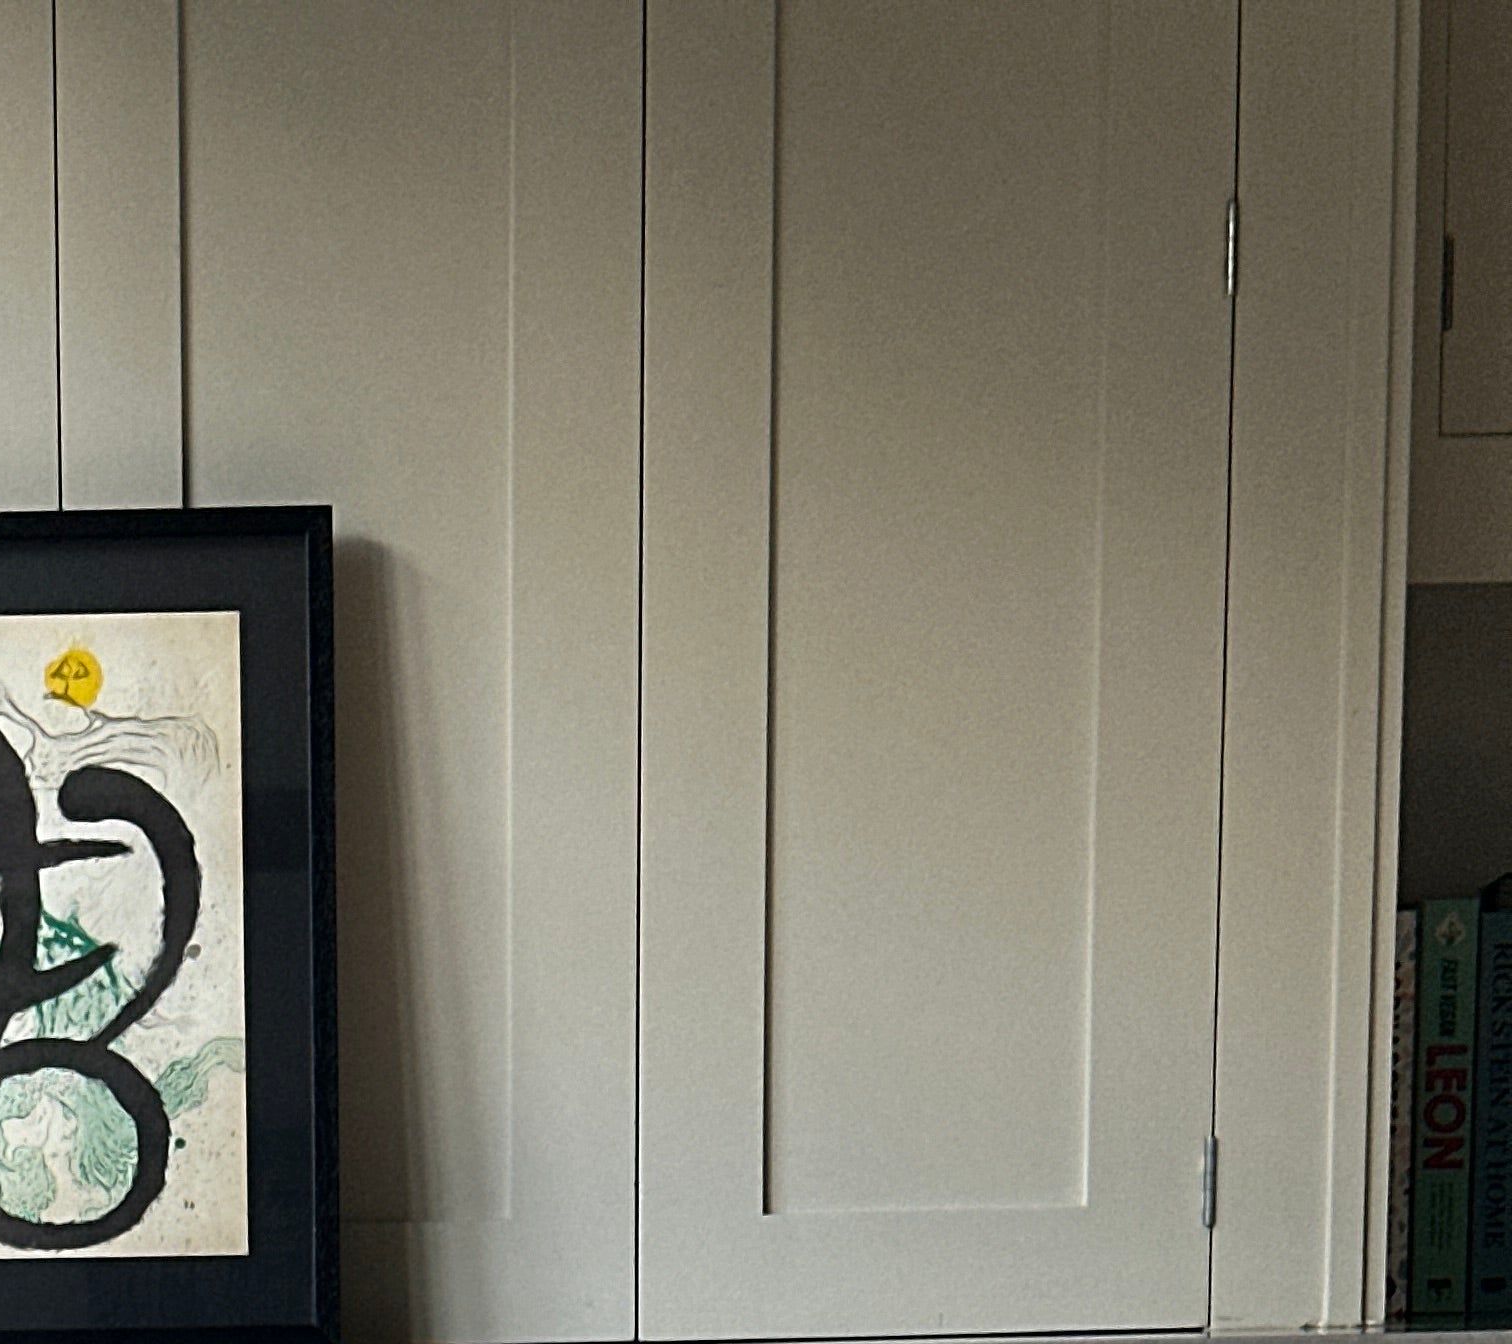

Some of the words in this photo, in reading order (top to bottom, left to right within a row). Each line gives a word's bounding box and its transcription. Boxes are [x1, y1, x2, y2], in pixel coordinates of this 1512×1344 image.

[1440, 958, 1459, 992] FAST
[1424, 1045, 1468, 1169] LEON
[1484, 1159, 1509, 1249] HOME
